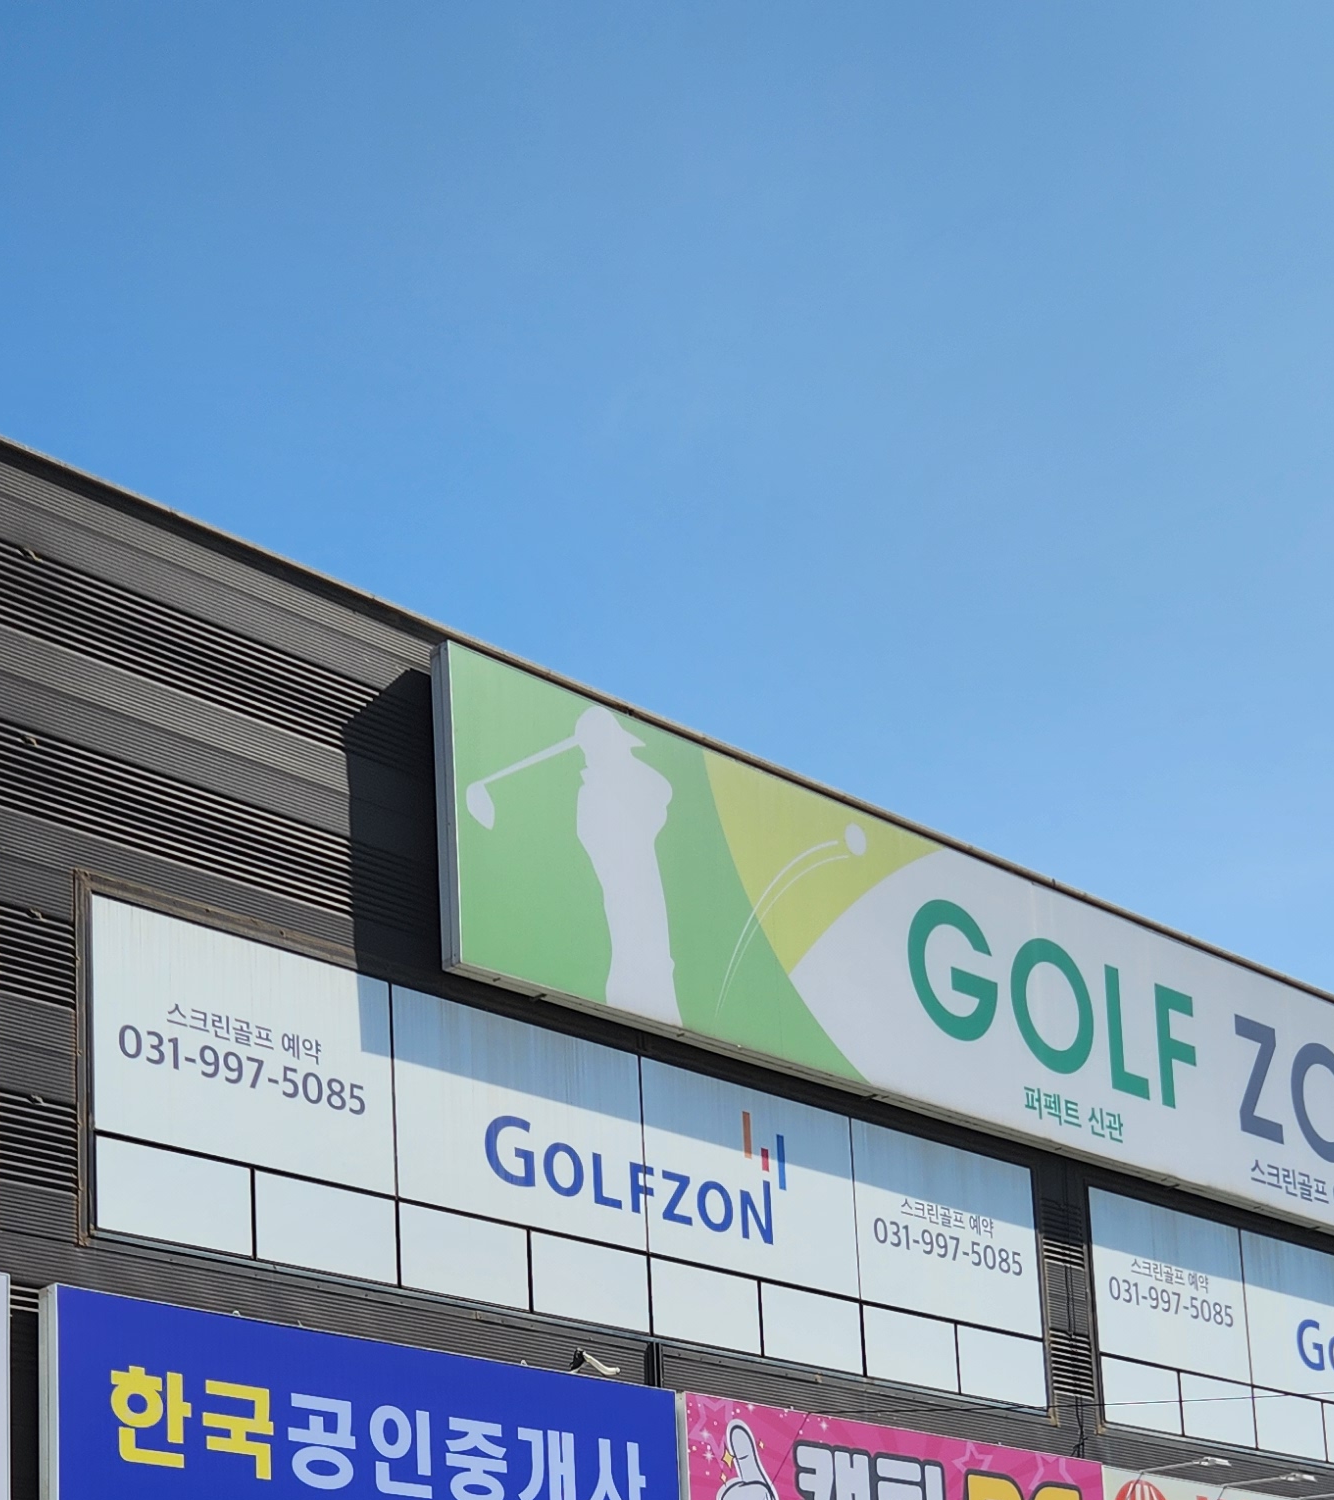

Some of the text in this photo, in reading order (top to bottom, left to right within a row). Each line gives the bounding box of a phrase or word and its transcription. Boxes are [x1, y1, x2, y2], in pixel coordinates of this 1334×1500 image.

[907, 898, 1198, 1110] GOLF
[165, 1002, 323, 1067] 스크린골프 예약
[116, 1023, 367, 1117] 031-997-5085
[1023, 1086, 1125, 1145] 퍼펙트 신관
[483, 1114, 776, 1247] GOLFZON
[1250, 1159, 1329, 1205] 스크린골프
[873, 1217, 1023, 1276] 031-997-5085
[900, 1198, 995, 1239] 스크린골프 예약
[1108, 1276, 1235, 1328] 031-997-5085
[1130, 1258, 1209, 1294] 스크린골프 예약
